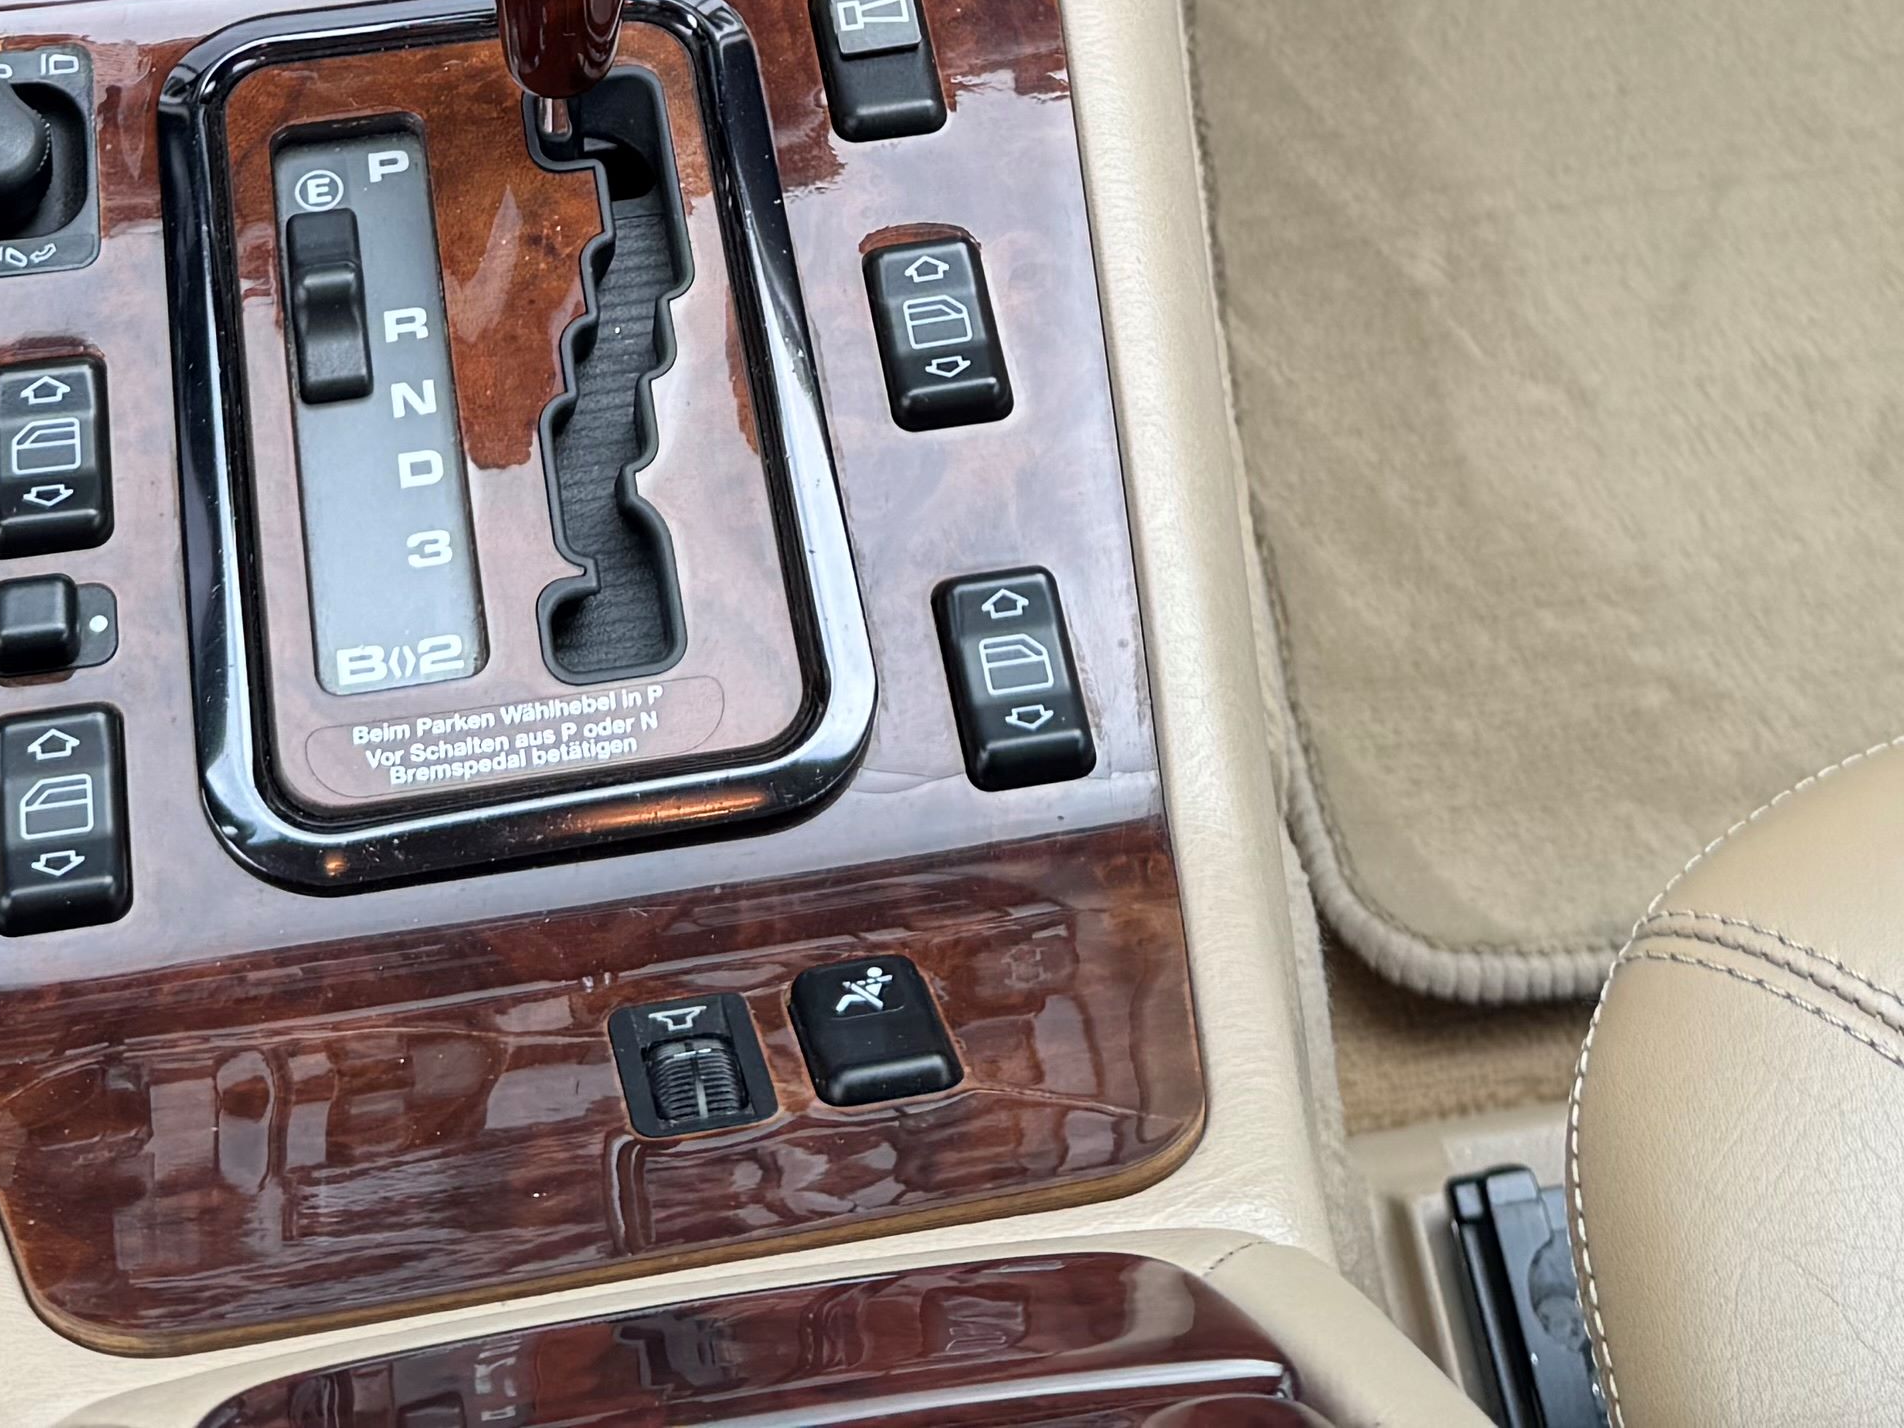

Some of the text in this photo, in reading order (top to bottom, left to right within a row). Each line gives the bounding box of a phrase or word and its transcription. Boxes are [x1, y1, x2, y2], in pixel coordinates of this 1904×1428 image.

[368, 150, 410, 183] P
[384, 307, 429, 342] R
[391, 379, 437, 418] N
[398, 450, 444, 488] D
[406, 530, 453, 568] 3
[352, 684, 663, 746] Beim Parken Wählhebel in P
[365, 710, 658, 769] Vor Schalten aus P oder N
[389, 734, 638, 786] Bremspedal betätigen
